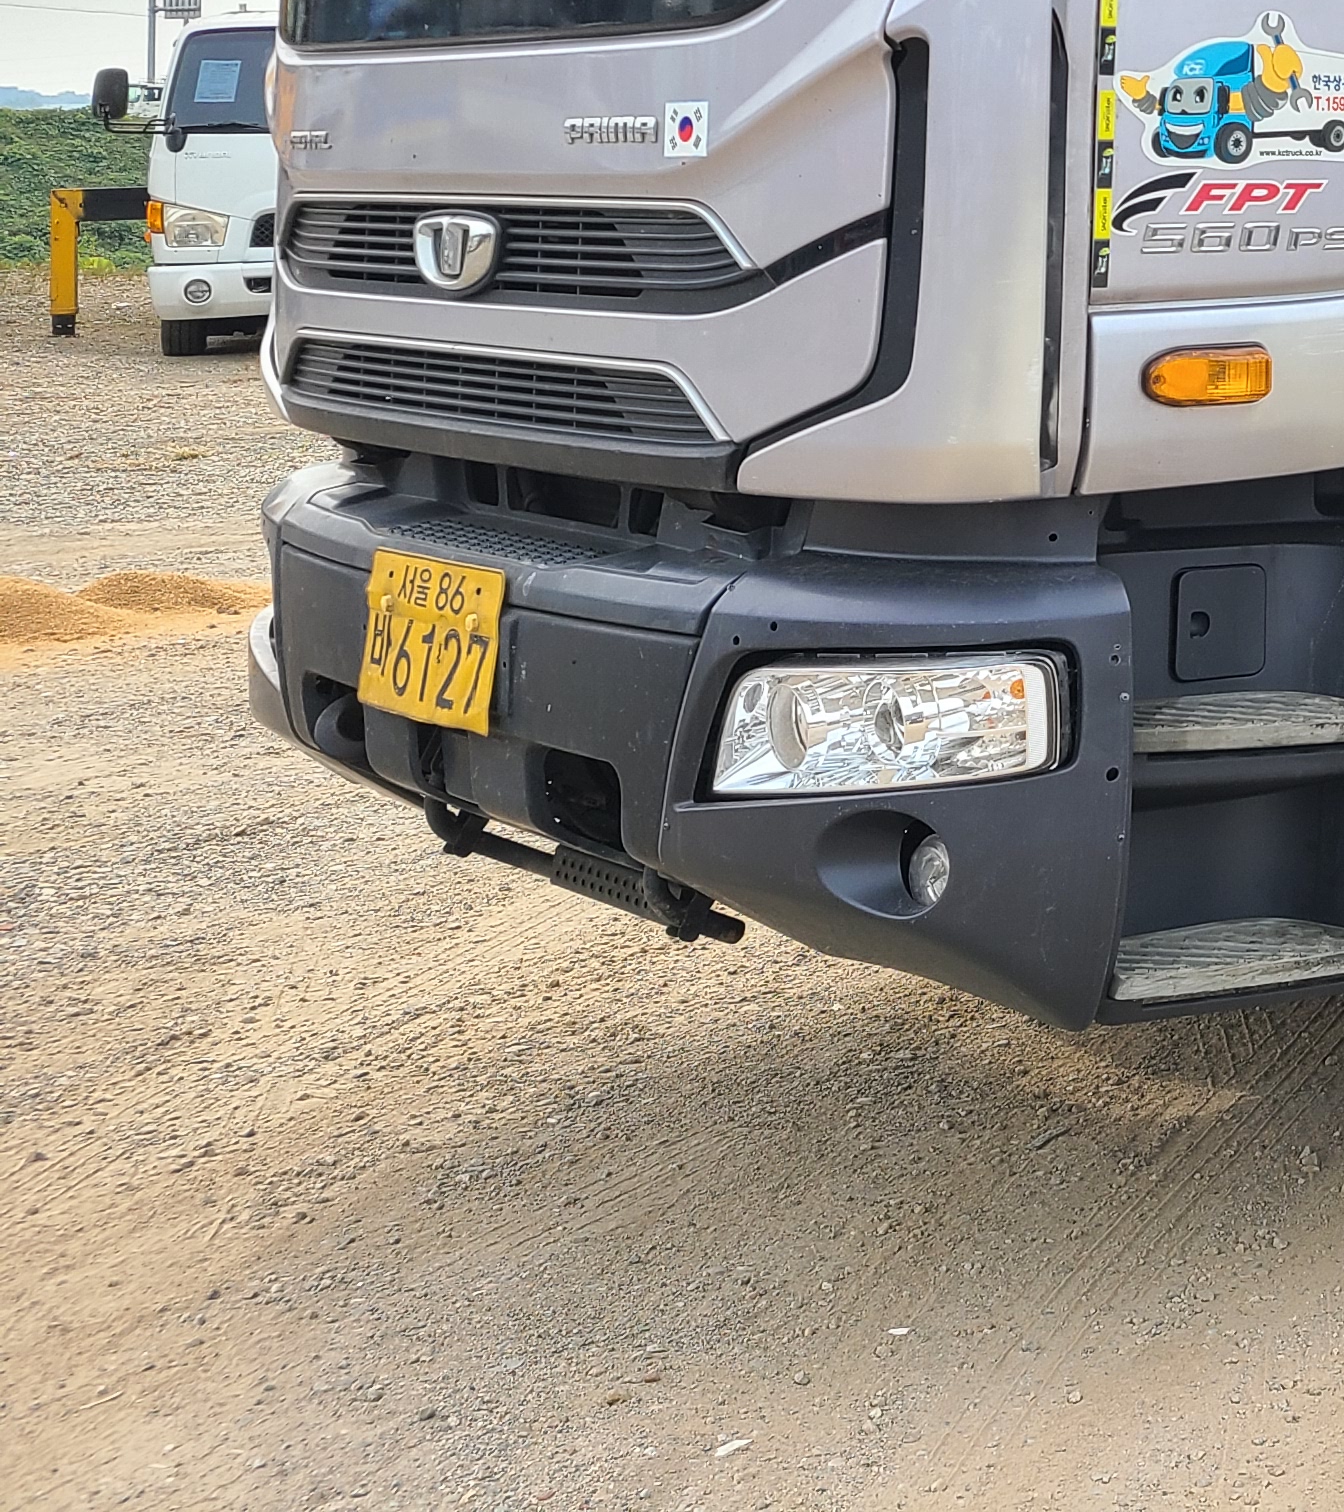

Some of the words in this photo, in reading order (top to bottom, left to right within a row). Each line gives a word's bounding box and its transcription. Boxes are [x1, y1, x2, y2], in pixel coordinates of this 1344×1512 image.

[563, 115, 660, 145] PRIMA
[1183, 181, 1325, 213] FPT
[397, 564, 433, 609] 서울
[434, 571, 467, 614] 86
